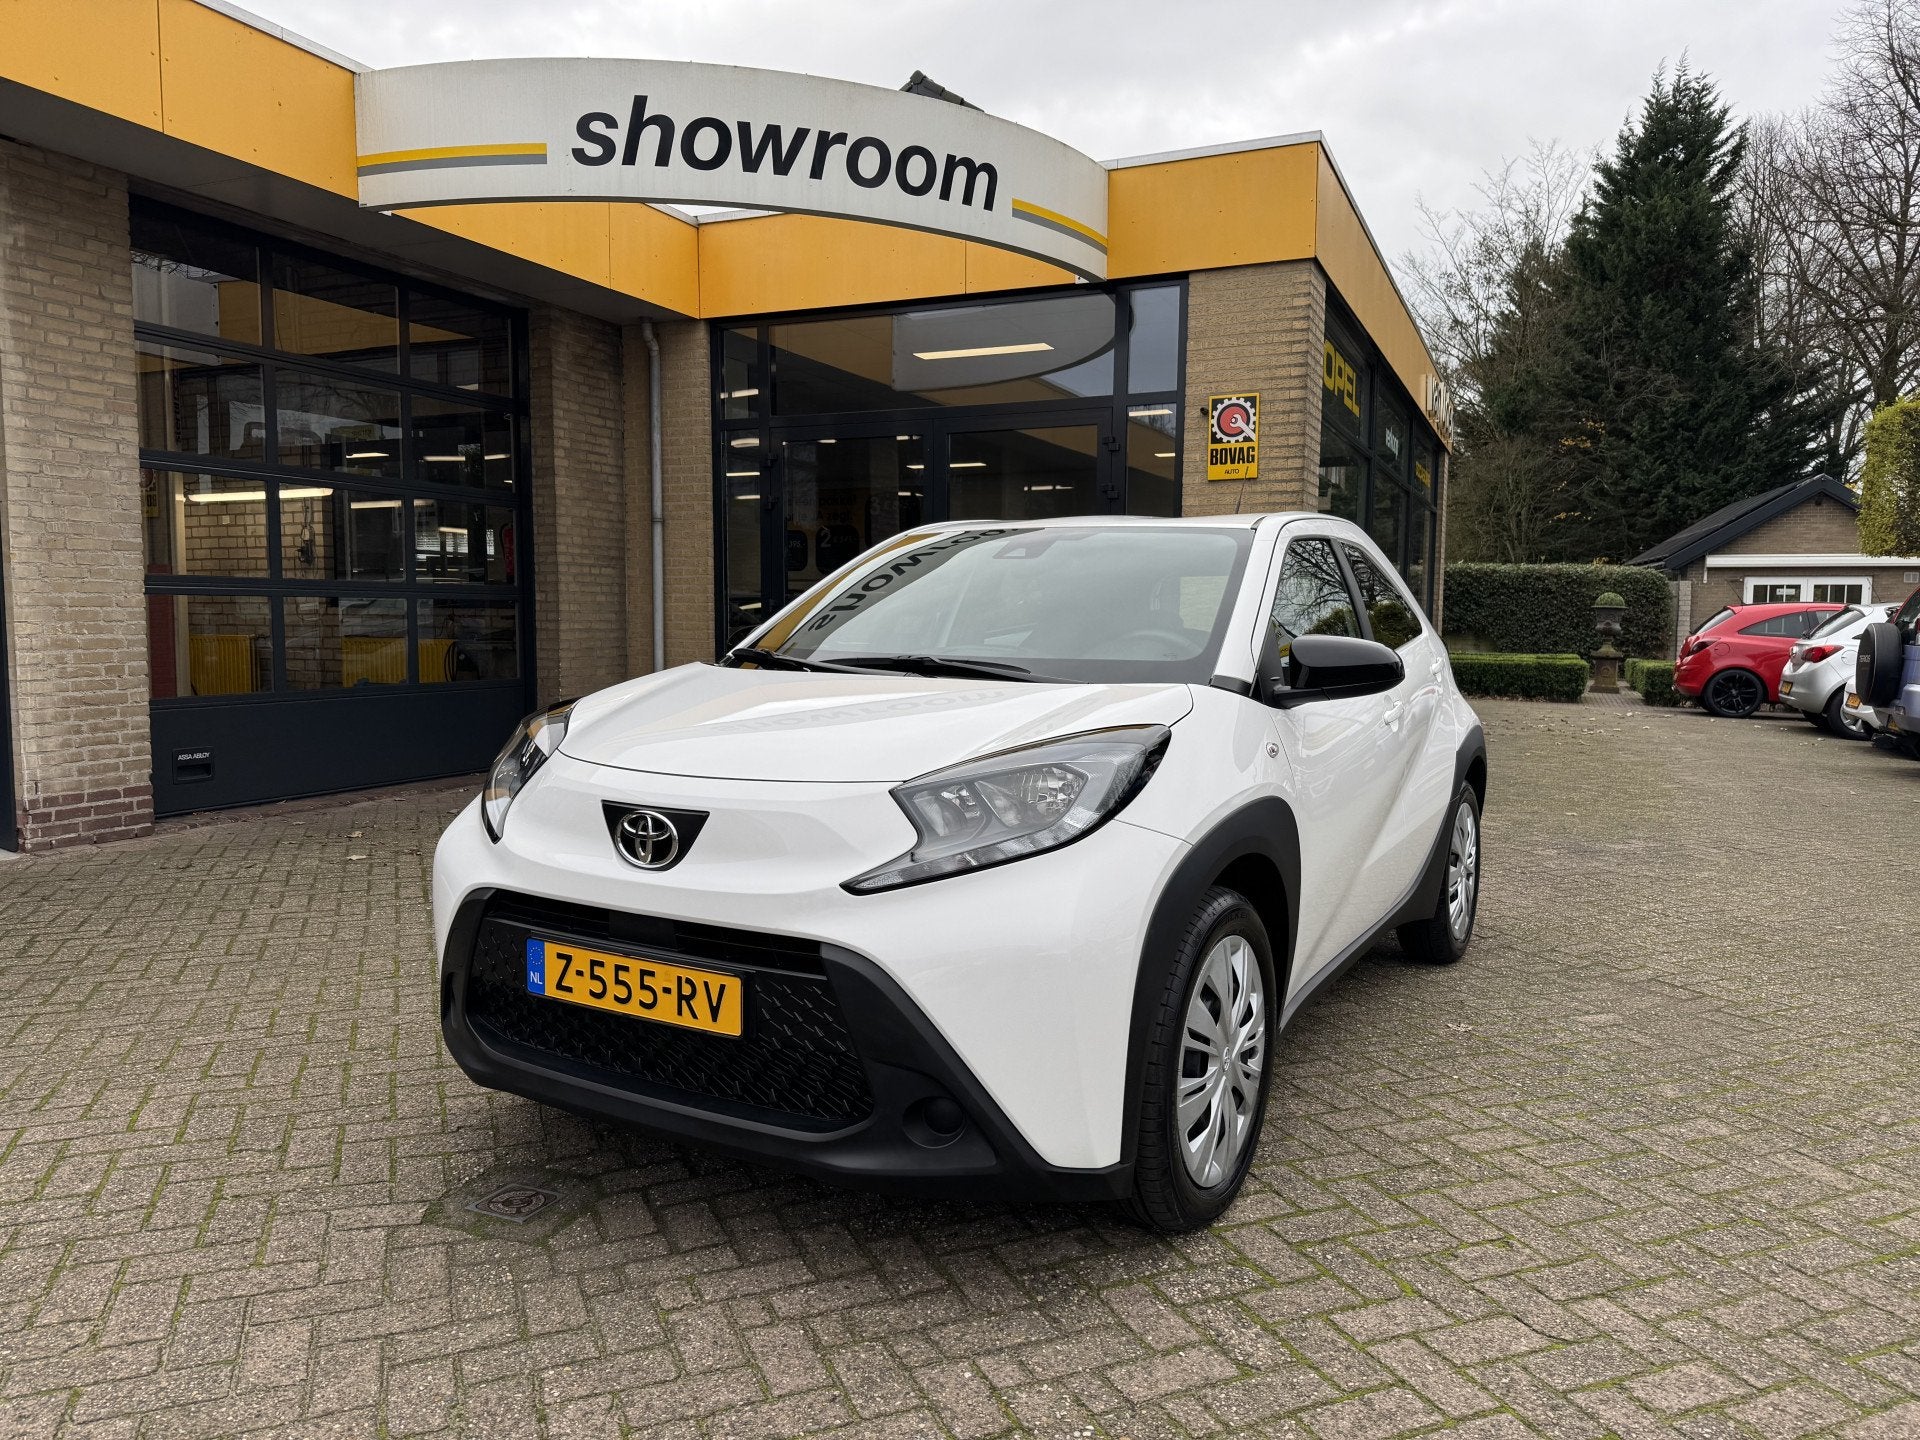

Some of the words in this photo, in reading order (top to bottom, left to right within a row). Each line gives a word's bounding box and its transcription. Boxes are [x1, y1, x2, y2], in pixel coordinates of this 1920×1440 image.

[571, 94, 999, 212] showroom
[1323, 339, 1360, 418] OPEL
[1210, 446, 1256, 466] BOVAG
[530, 971, 543, 985] NL
[555, 952, 726, 1023] Z-555-RV
